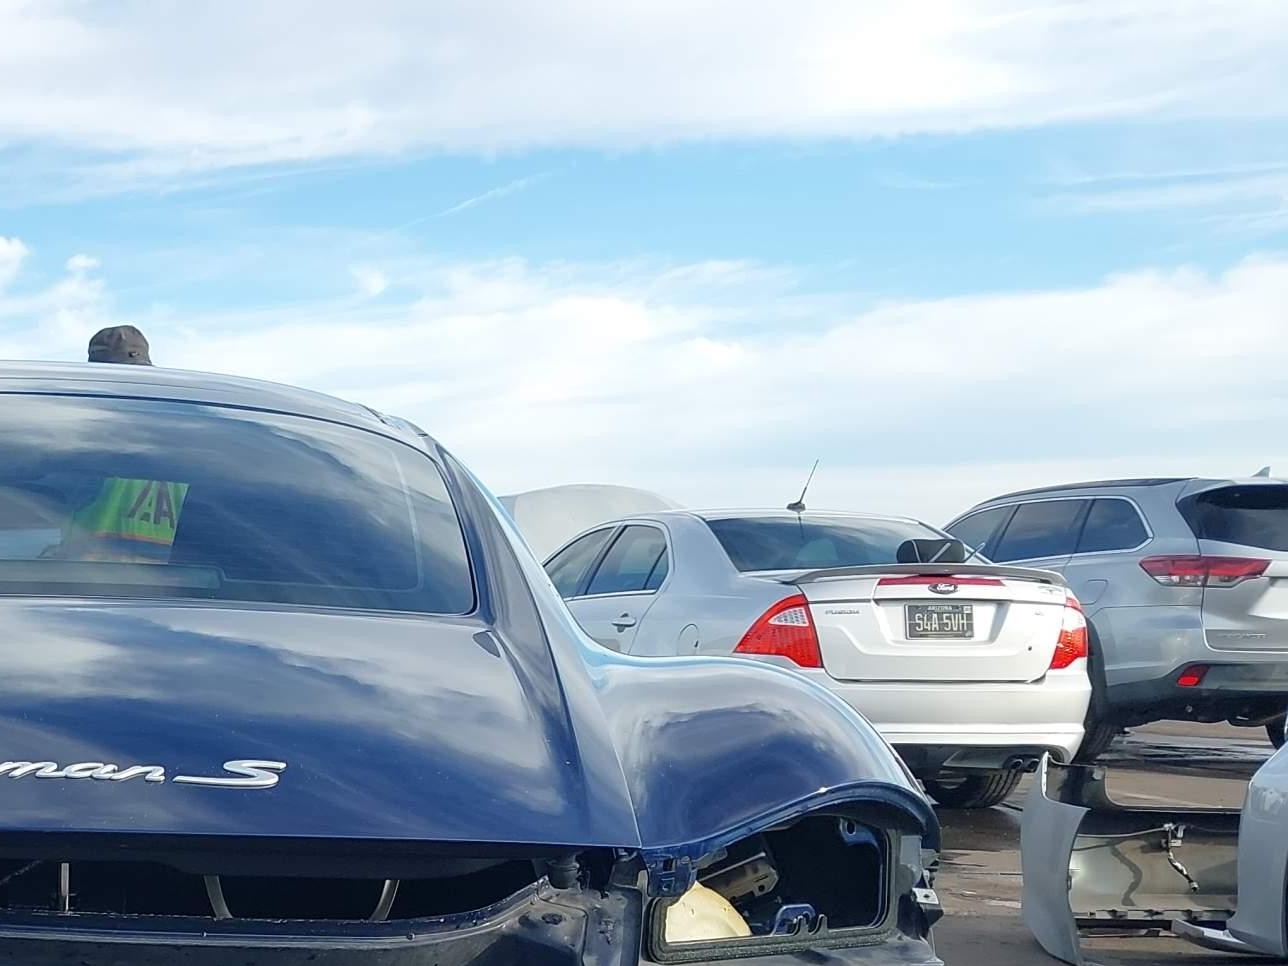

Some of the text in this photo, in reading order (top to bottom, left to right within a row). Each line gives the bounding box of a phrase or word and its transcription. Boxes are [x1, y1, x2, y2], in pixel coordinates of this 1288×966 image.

[915, 613, 967, 631] S4A 5VH
[172, 759, 287, 790] S
